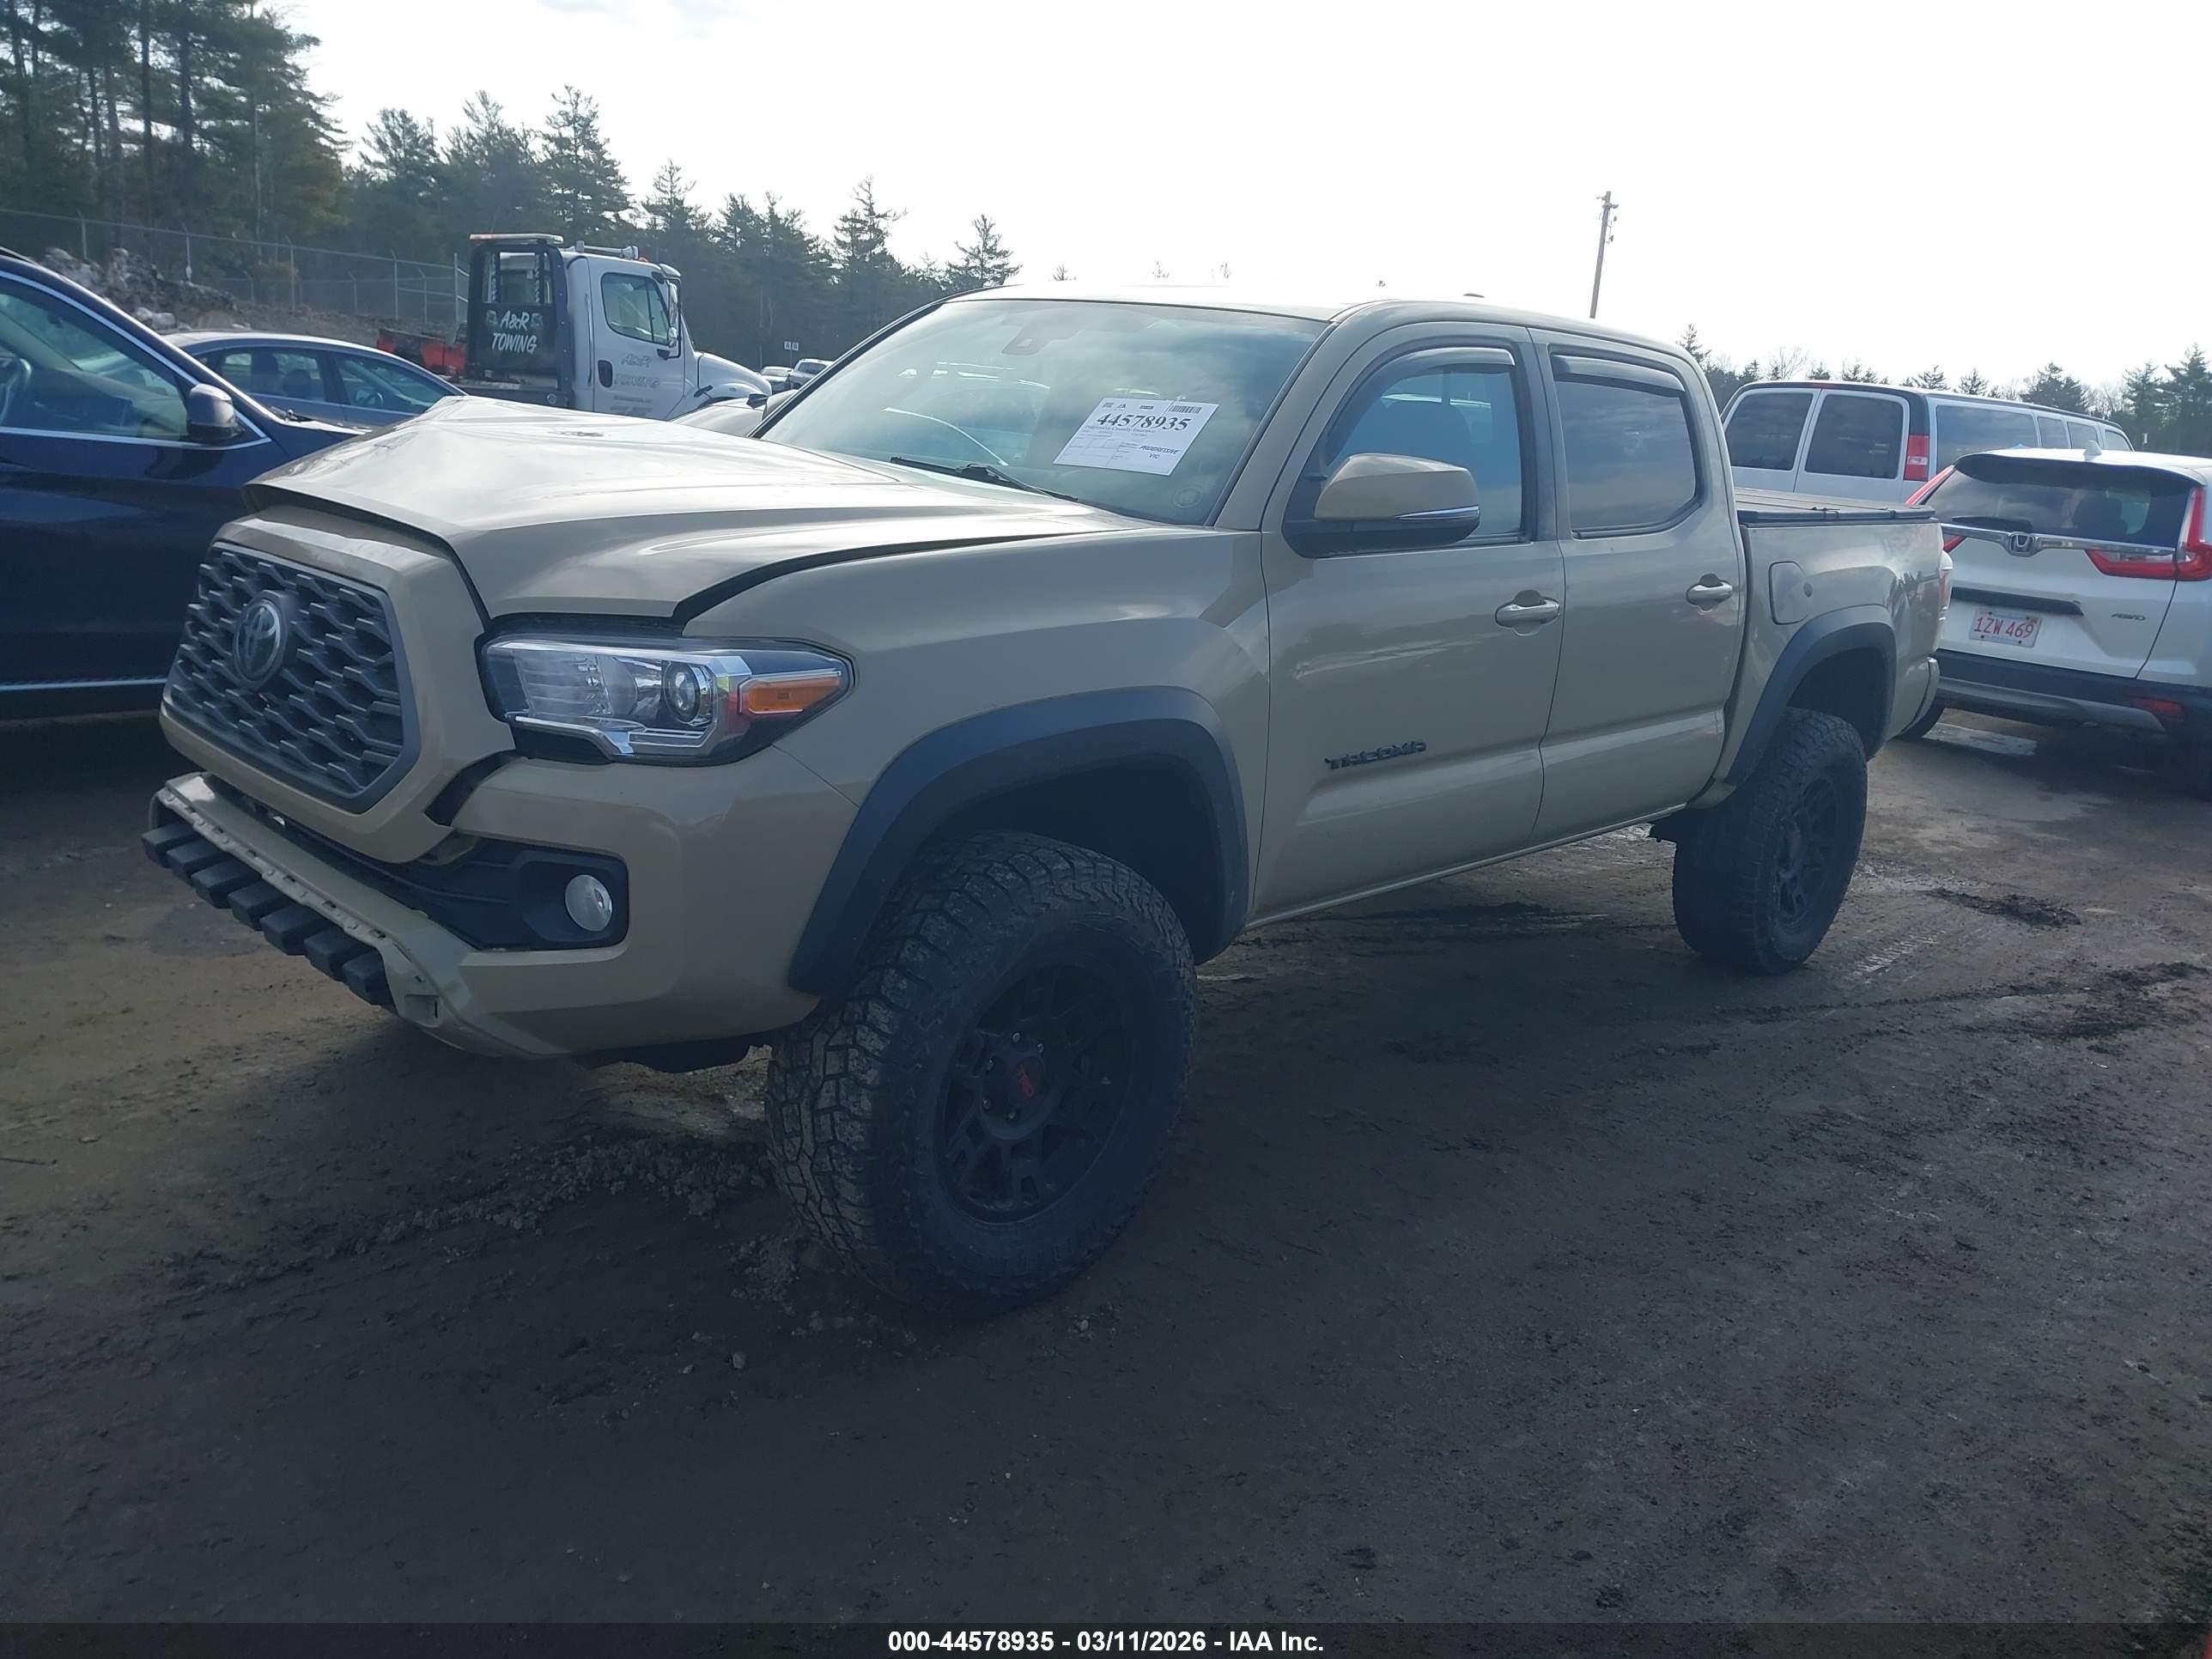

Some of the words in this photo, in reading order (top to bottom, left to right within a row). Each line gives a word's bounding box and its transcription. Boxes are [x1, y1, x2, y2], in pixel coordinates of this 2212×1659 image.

[500, 310, 530, 331] A&R
[491, 332, 538, 355] TOWING
[1097, 412, 1193, 431] 44578935
[1973, 617, 2004, 635] 1ZW
[2005, 621, 2035, 639] 469
